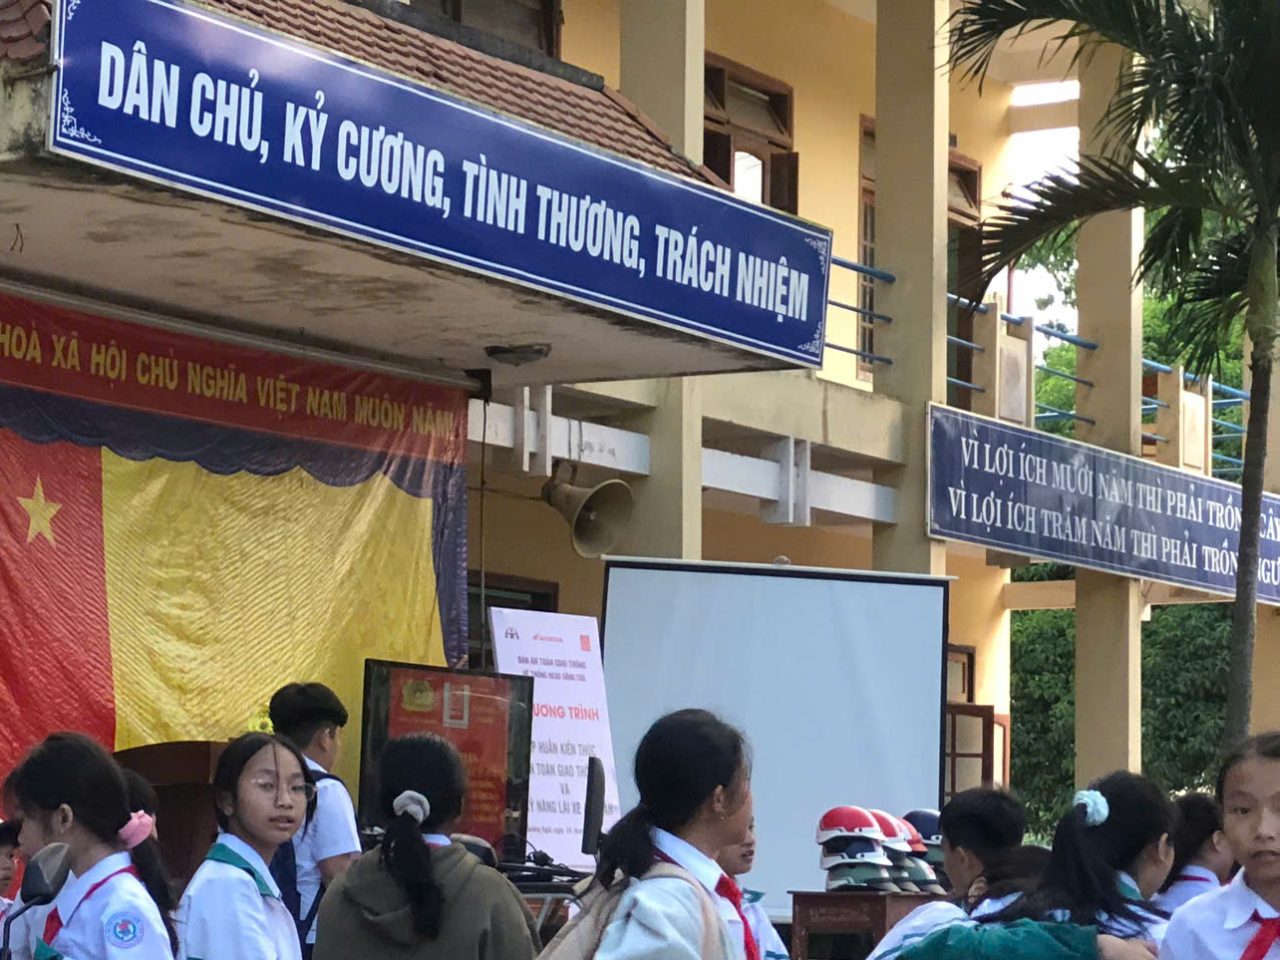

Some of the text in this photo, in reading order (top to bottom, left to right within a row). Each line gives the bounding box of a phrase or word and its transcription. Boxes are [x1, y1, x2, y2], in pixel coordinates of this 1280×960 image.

[98, 40, 809, 322] DÂN CHỦ, KỶ CƯƠNG, TÌNH THƯƠNG, TRÁCH NHIỆM
[51, 330, 80, 372] XÃ
[90, 340, 127, 389] HỘI
[136, 348, 178, 390] CHỦ
[187, 363, 247, 404] NGHĨA
[256, 374, 300, 420] VIỆT
[307, 386, 346, 421] NAM
[354, 394, 404, 431] MUÔN
[948, 480, 966, 520] VÌ
[972, 491, 1002, 533] LỢI
[1007, 491, 1036, 535] ÍCH
[1041, 507, 1087, 545] TRĂM
[1090, 515, 1126, 553] NĂM
[1131, 526, 1157, 560] THÌ
[1162, 530, 1197, 568] PHẢI
[1202, 538, 1239, 576] TRỒN
[961, 429, 979, 470] VÌ
[984, 443, 1014, 486] LỢI
[1018, 442, 1047, 486] ÍCH
[1099, 470, 1133, 507] NĂM
[1136, 478, 1162, 514] THÌ
[1166, 484, 1203, 523] PHẢI
[1207, 494, 1242, 532] TRỒN
[532, 703, 599, 721] ƯƠNG TRÌNH
[557, 764, 574, 777] GIAO
[572, 802, 582, 815] XE
